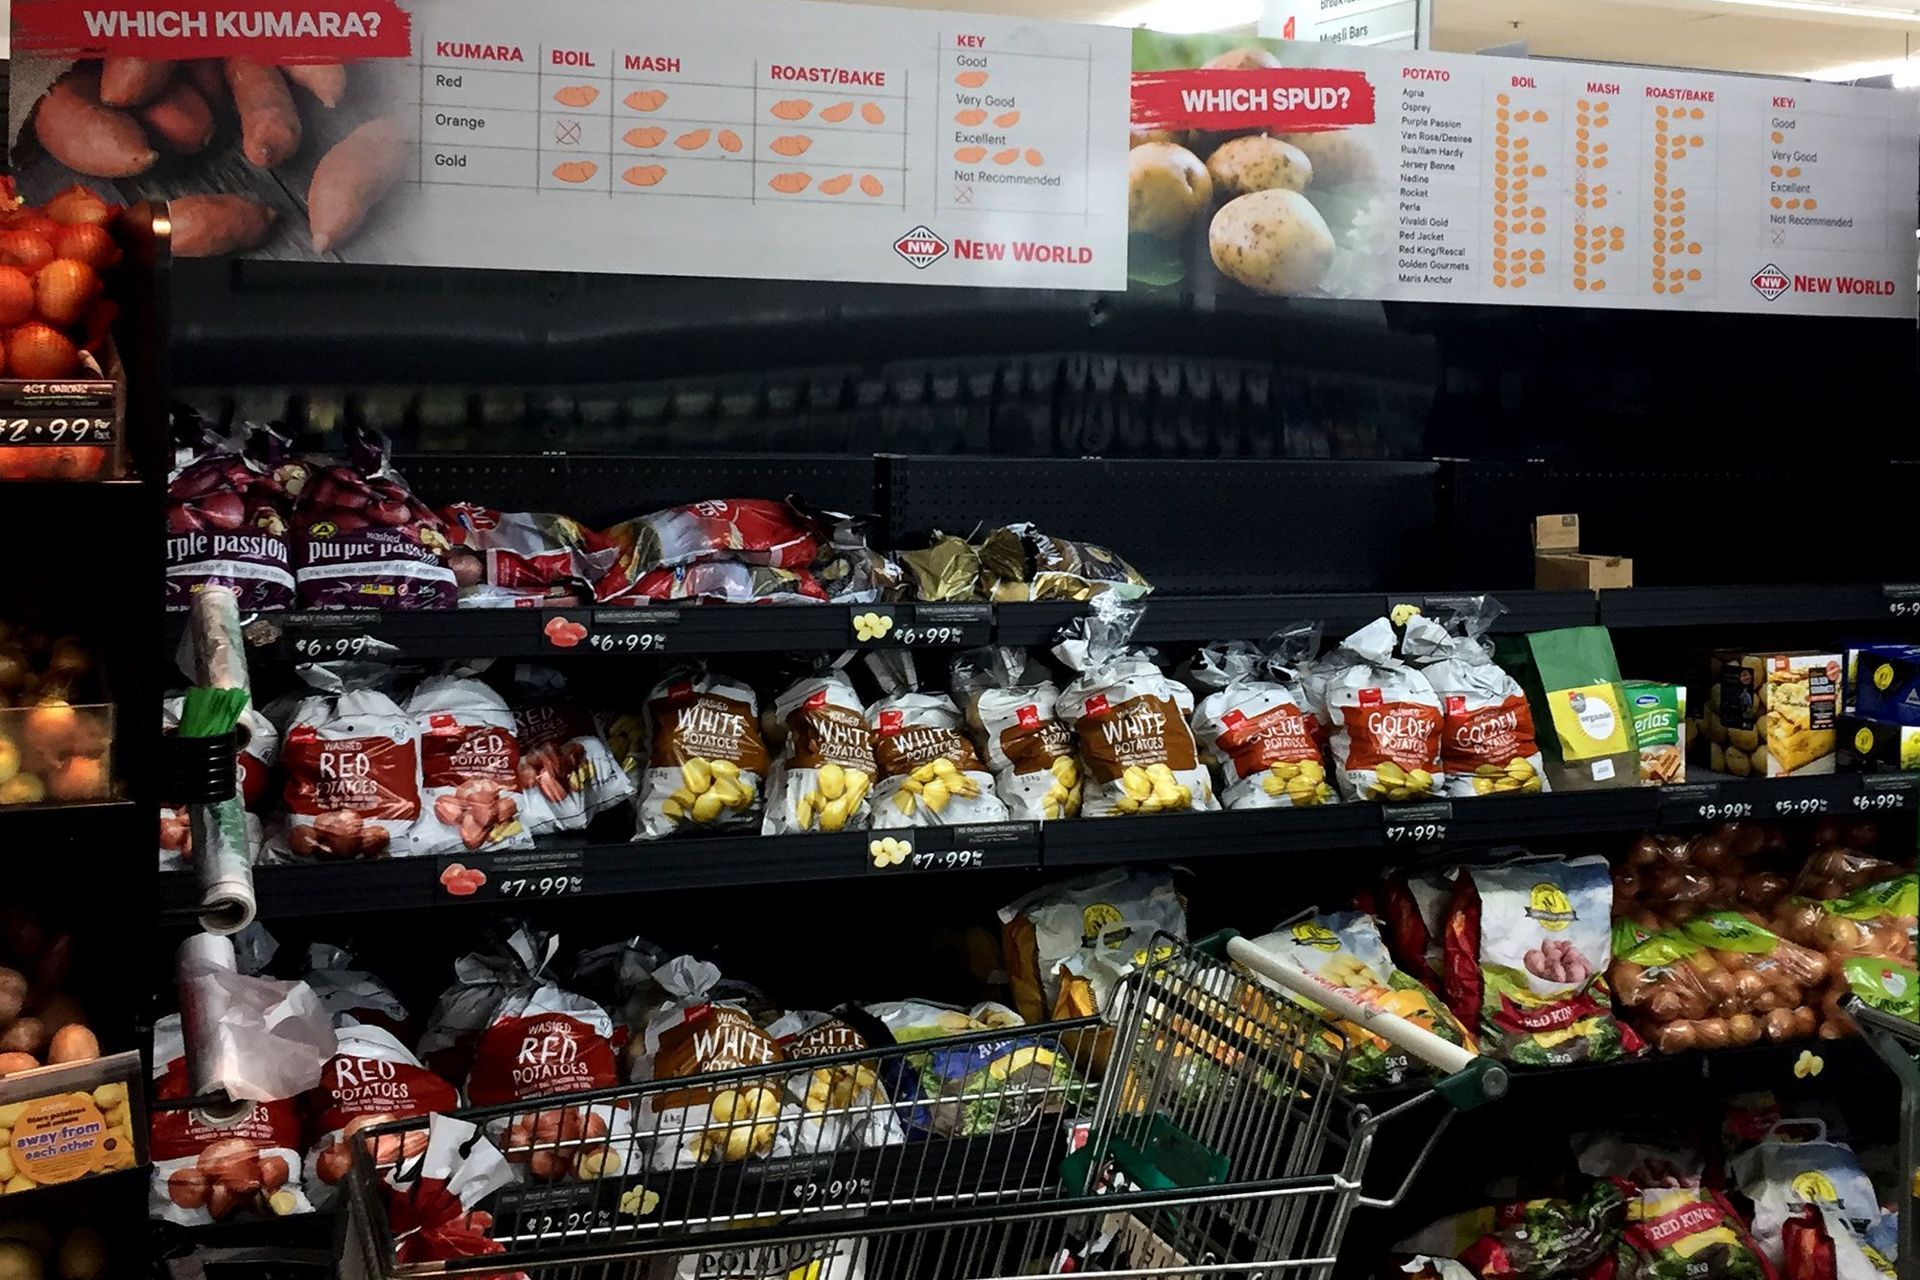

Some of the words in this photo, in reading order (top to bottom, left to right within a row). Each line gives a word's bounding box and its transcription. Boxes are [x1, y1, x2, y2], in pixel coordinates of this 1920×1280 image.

[84, 11, 207, 38] WHICH
[216, 9, 382, 38] KUMARA?
[957, 34, 986, 48] KEY
[1320, 28, 1347, 43] Muesli
[1349, 25, 1368, 40] Bars
[436, 42, 524, 63] KUMARA
[552, 49, 596, 68] BOIL
[625, 55, 681, 73] MASH
[956, 55, 988, 68] Good
[436, 75, 463, 88] Red
[771, 65, 886, 87] ROAST/BAKE
[1402, 68, 1450, 82] POTATO
[1511, 76, 1537, 88] BOIL
[1402, 88, 1424, 98] Agria
[1587, 82, 1620, 95] MASH
[1645, 87, 1715, 102] ROAST/BAKE
[956, 94, 979, 109] Very
[983, 96, 1016, 108] Good
[1181, 88, 1268, 113] WHICH
[1273, 86, 1352, 111] SPUD?
[1402, 102, 1431, 113] Osprey
[435, 114, 486, 131] Orange
[1401, 116, 1428, 127] Purple
[1430, 118, 1461, 129] Passion
[1771, 118, 1796, 129] Good
[955, 132, 1007, 146] Excellent
[1401, 131, 1417, 140] Van
[435, 153, 467, 168] Gold
[1439, 148, 1464, 159] Hardy
[1771, 151, 1792, 162] Very
[1793, 152, 1817, 163] Good
[954, 170, 976, 184] Not
[979, 171, 1062, 187] Recommended
[1770, 181, 1811, 193] Excellent
[1400, 187, 1429, 198] Rocket
[1400, 202, 1421, 212] Perla
[1400, 217, 1427, 227] Vivaldi
[1429, 218, 1449, 227] Gold
[1770, 214, 1786, 225] Not
[1788, 215, 1853, 228] Recommended
[1399, 231, 1415, 240] Red
[1417, 231, 1445, 242] Jacket
[904, 240, 937, 255] NW
[953, 238, 1005, 262] NEW
[1012, 241, 1093, 265] WORLD
[1399, 245, 1415, 254] Red
[1399, 259, 1428, 269] Golden
[1430, 260, 1470, 271] Gourmets
[1399, 274, 1421, 283] Maris
[1424, 275, 1453, 284] Anchor
[1761, 277, 1781, 288] NW
[1794, 275, 1832, 293] NEW
[1836, 277, 1895, 296] WORLD
[366, 531, 401, 543] washed
[167, 532, 208, 562] rple
[213, 534, 288, 564] passion
[590, 634, 652, 652] $6.99
[893, 627, 951, 646] $6.99
[677, 705, 745, 738] WHITE
[1102, 712, 1166, 746] WHITE
[1368, 712, 1436, 737] GOLDEN
[1456, 711, 1518, 748] GOLDEN
[1634, 713, 1670, 733] erlas
[682, 731, 740, 750] POTATOES
[811, 718, 874, 751] WHITE
[1114, 737, 1164, 755] POTATOES
[320, 753, 370, 780] RED
[1775, 798, 1820, 816] $5.99
[1853, 794, 1896, 811] $6.99
[1699, 804, 1743, 820] $8.99
[1386, 824, 1436, 842] $7.99
[912, 850, 971, 870] $7.99
[501, 876, 568, 897] $7.99
[1524, 1014, 1549, 1028] RED
[1553, 1006, 1574, 1024] KIN
[528, 1020, 572, 1036] WASHED
[519, 1036, 578, 1065] RED
[693, 1026, 775, 1065] WHITE
[335, 1057, 396, 1089] RED
[512, 1061, 589, 1085] POTATOES
[332, 1082, 409, 1101] POTATOES
[17, 1132, 57, 1148] away
[61, 1123, 100, 1138] from
[25, 1147, 57, 1161] each
[60, 1139, 95, 1154] other
[1650, 1219, 1680, 1240] RED
[1686, 1262, 1709, 1276] 5KG
